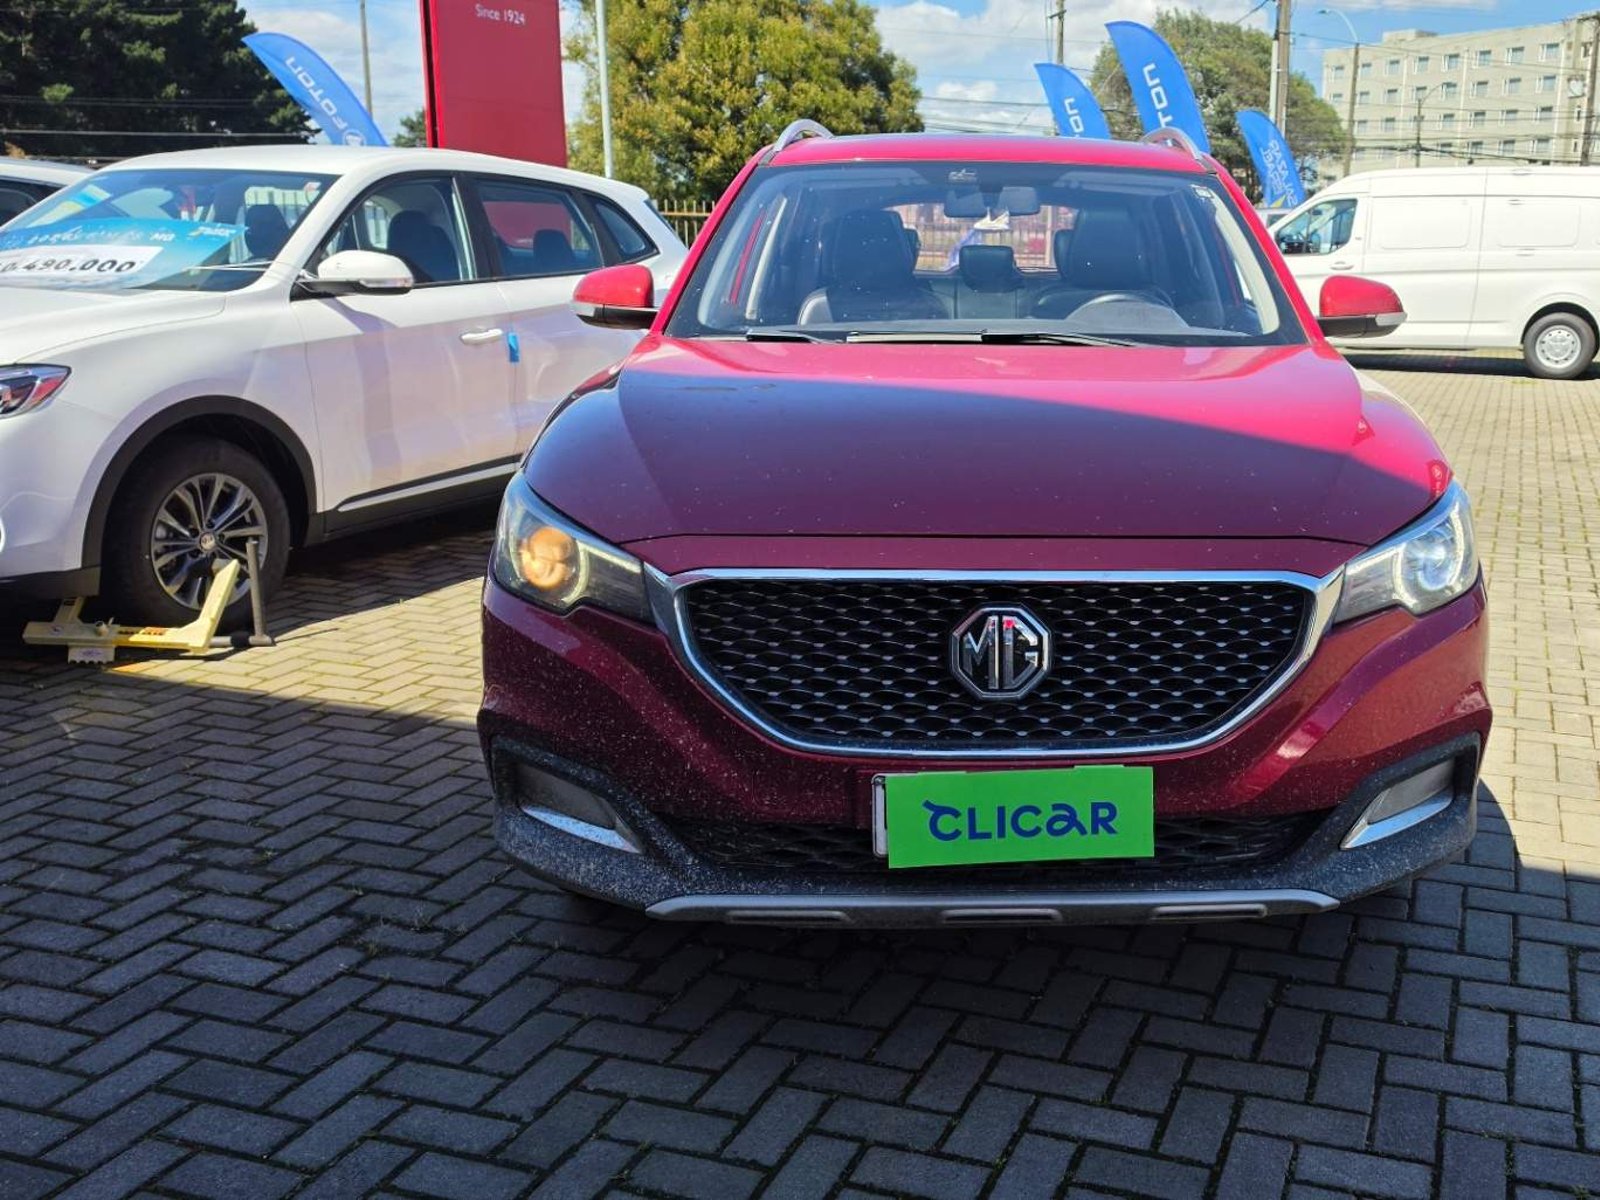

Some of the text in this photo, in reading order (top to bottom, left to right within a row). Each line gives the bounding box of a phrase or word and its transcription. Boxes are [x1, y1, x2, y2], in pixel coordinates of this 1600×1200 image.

[475, 4, 525, 25] Since 1924
[1143, 63, 1173, 129] TON
[1064, 97, 1084, 137] ON
[0, 259, 136, 273] 0.490.000
[962, 615, 1038, 690] MG
